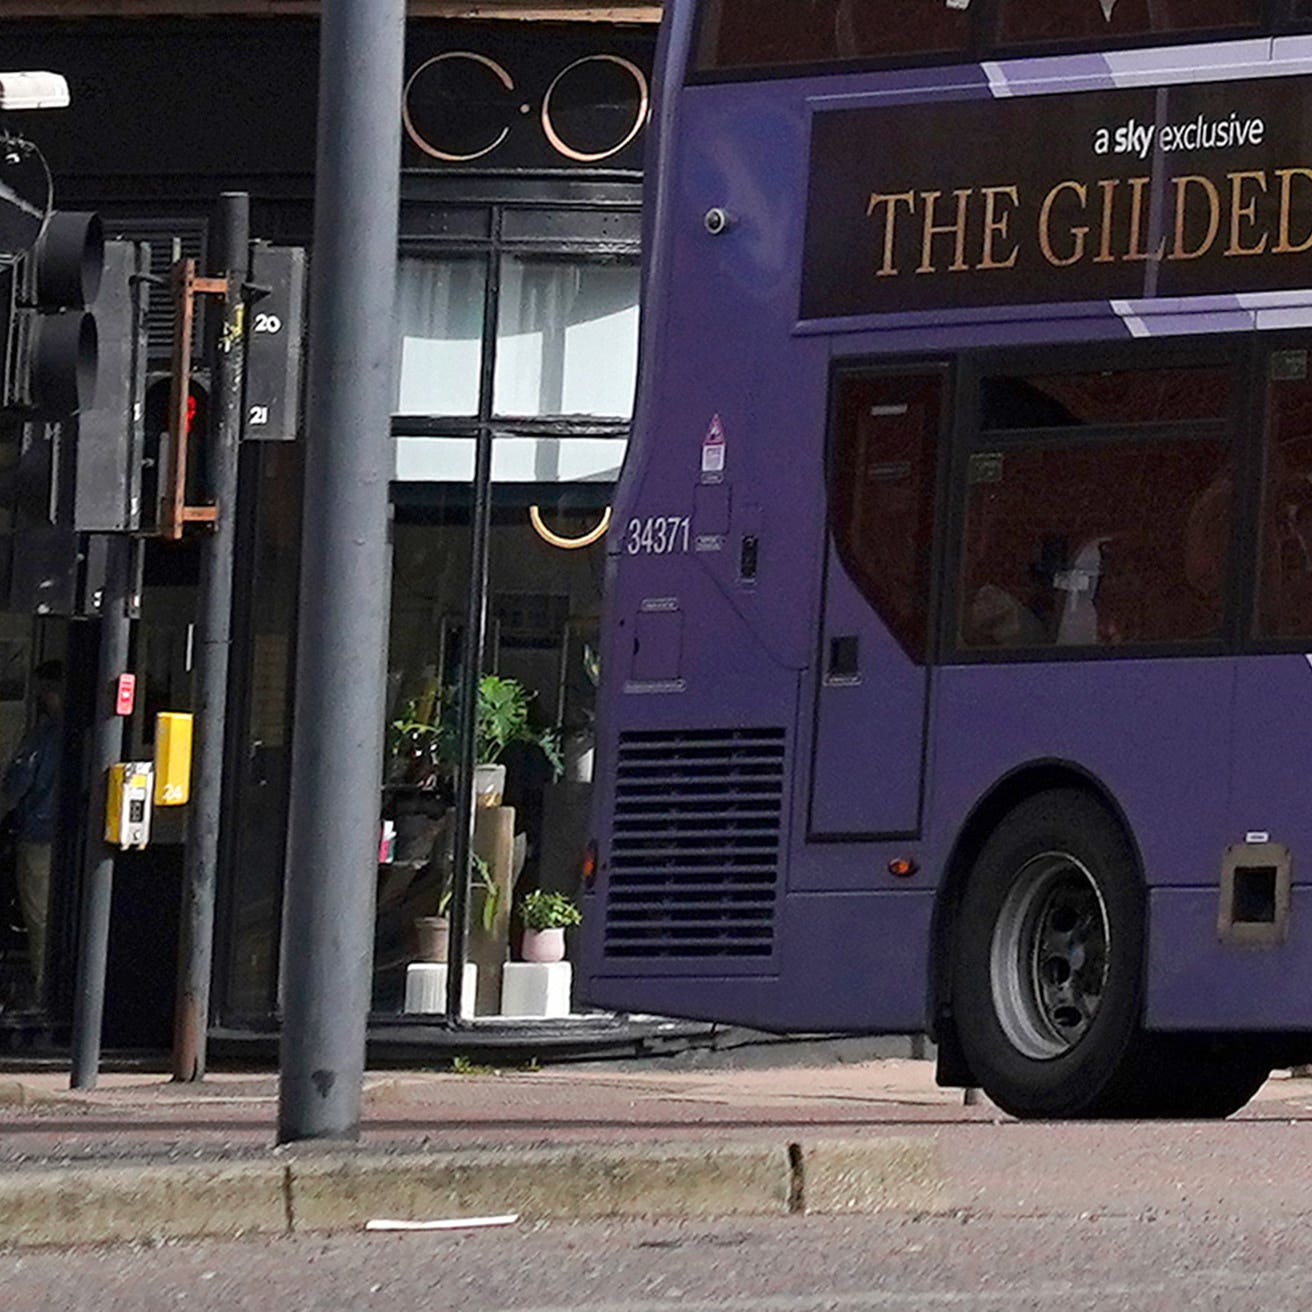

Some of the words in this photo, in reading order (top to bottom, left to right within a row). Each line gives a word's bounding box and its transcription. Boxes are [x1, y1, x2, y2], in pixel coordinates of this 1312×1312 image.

[1094, 127, 1109, 155] a
[1114, 118, 1155, 159] sky
[1159, 112, 1265, 152] exclusive
[866, 184, 1021, 277] THE
[255, 315, 282, 334] 20
[250, 406, 268, 425] 21
[626, 517, 691, 555] 34371
